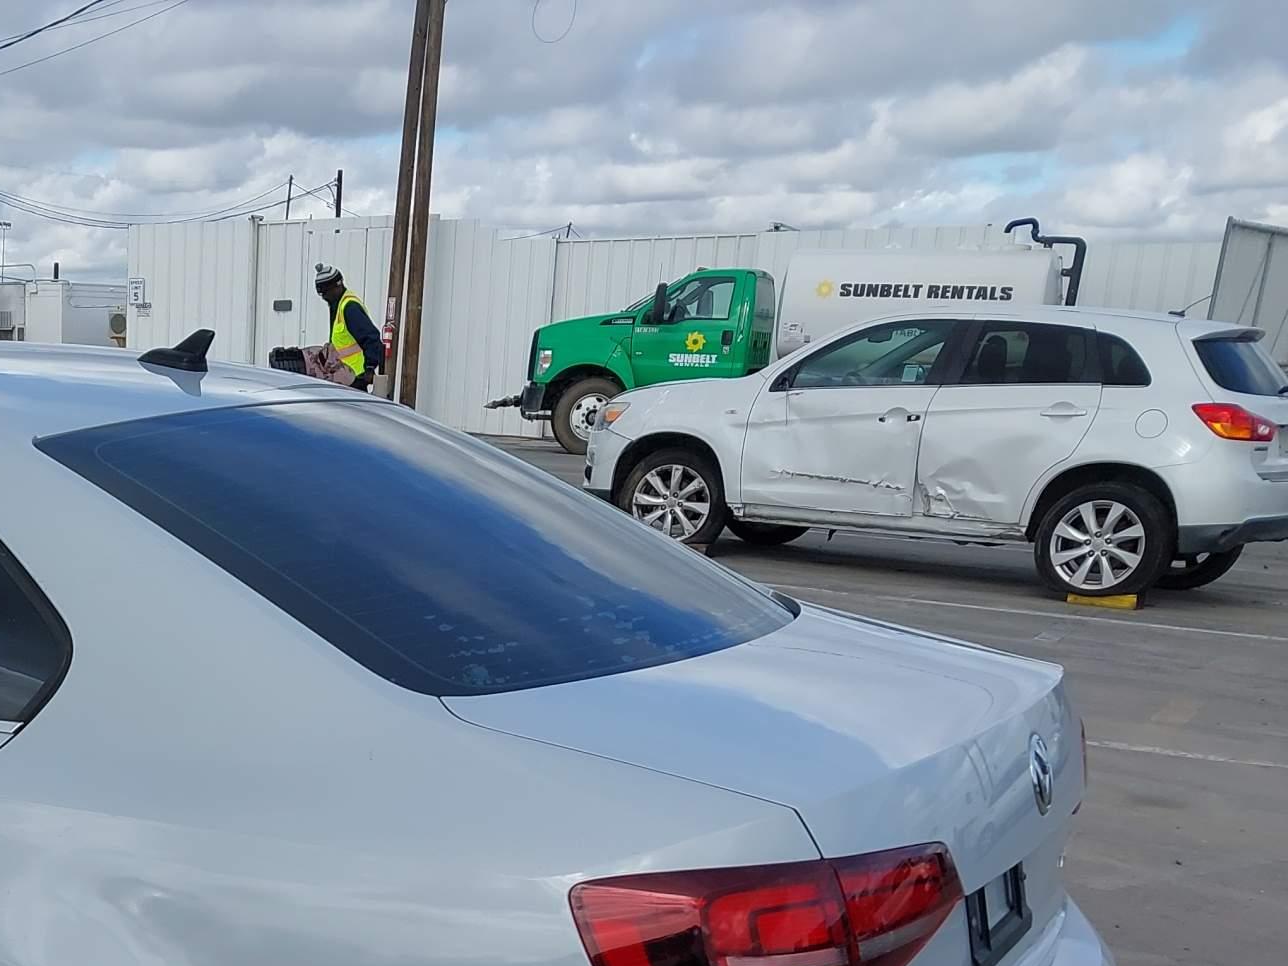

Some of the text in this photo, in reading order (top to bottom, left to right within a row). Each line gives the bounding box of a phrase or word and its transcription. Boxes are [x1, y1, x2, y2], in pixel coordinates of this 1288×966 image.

[133, 291, 139, 302] 5
[839, 283, 1014, 301] SUNBELT RENTALS
[668, 353, 718, 364] SUNBELT
